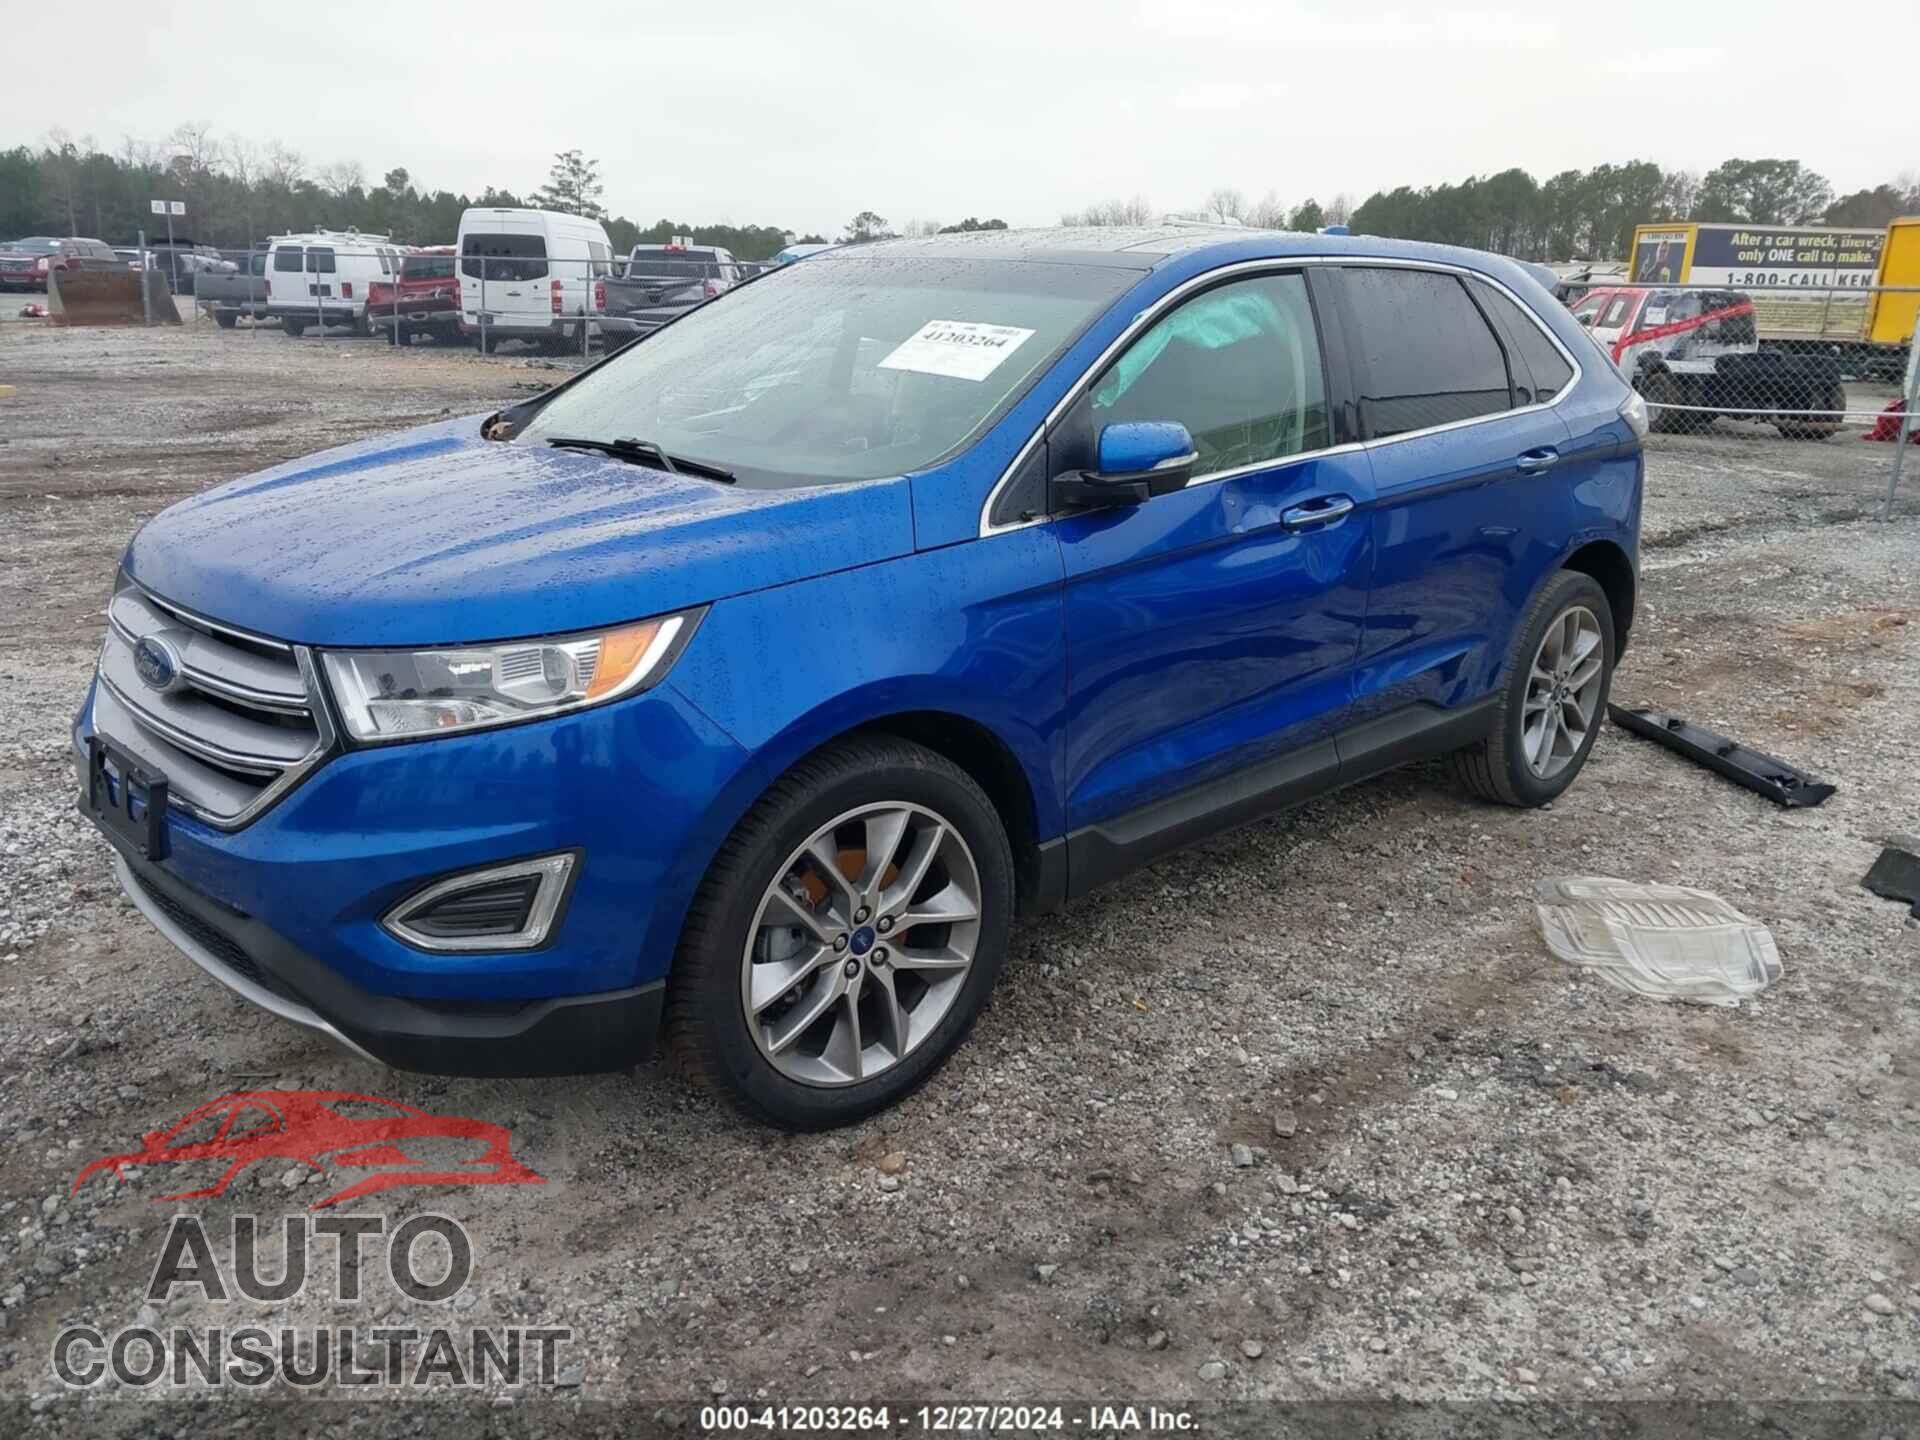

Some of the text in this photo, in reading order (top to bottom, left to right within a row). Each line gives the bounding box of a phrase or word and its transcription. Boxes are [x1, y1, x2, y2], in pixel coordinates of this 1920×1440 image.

[1730, 232, 1763, 247] After
[1764, 236, 1773, 246] a
[1775, 236, 1795, 247] car
[1797, 235, 1838, 249] wreck,
[1737, 248, 1875, 264] only ONE call to make.
[1727, 272, 1873, 287] 1-800-CALL KEN
